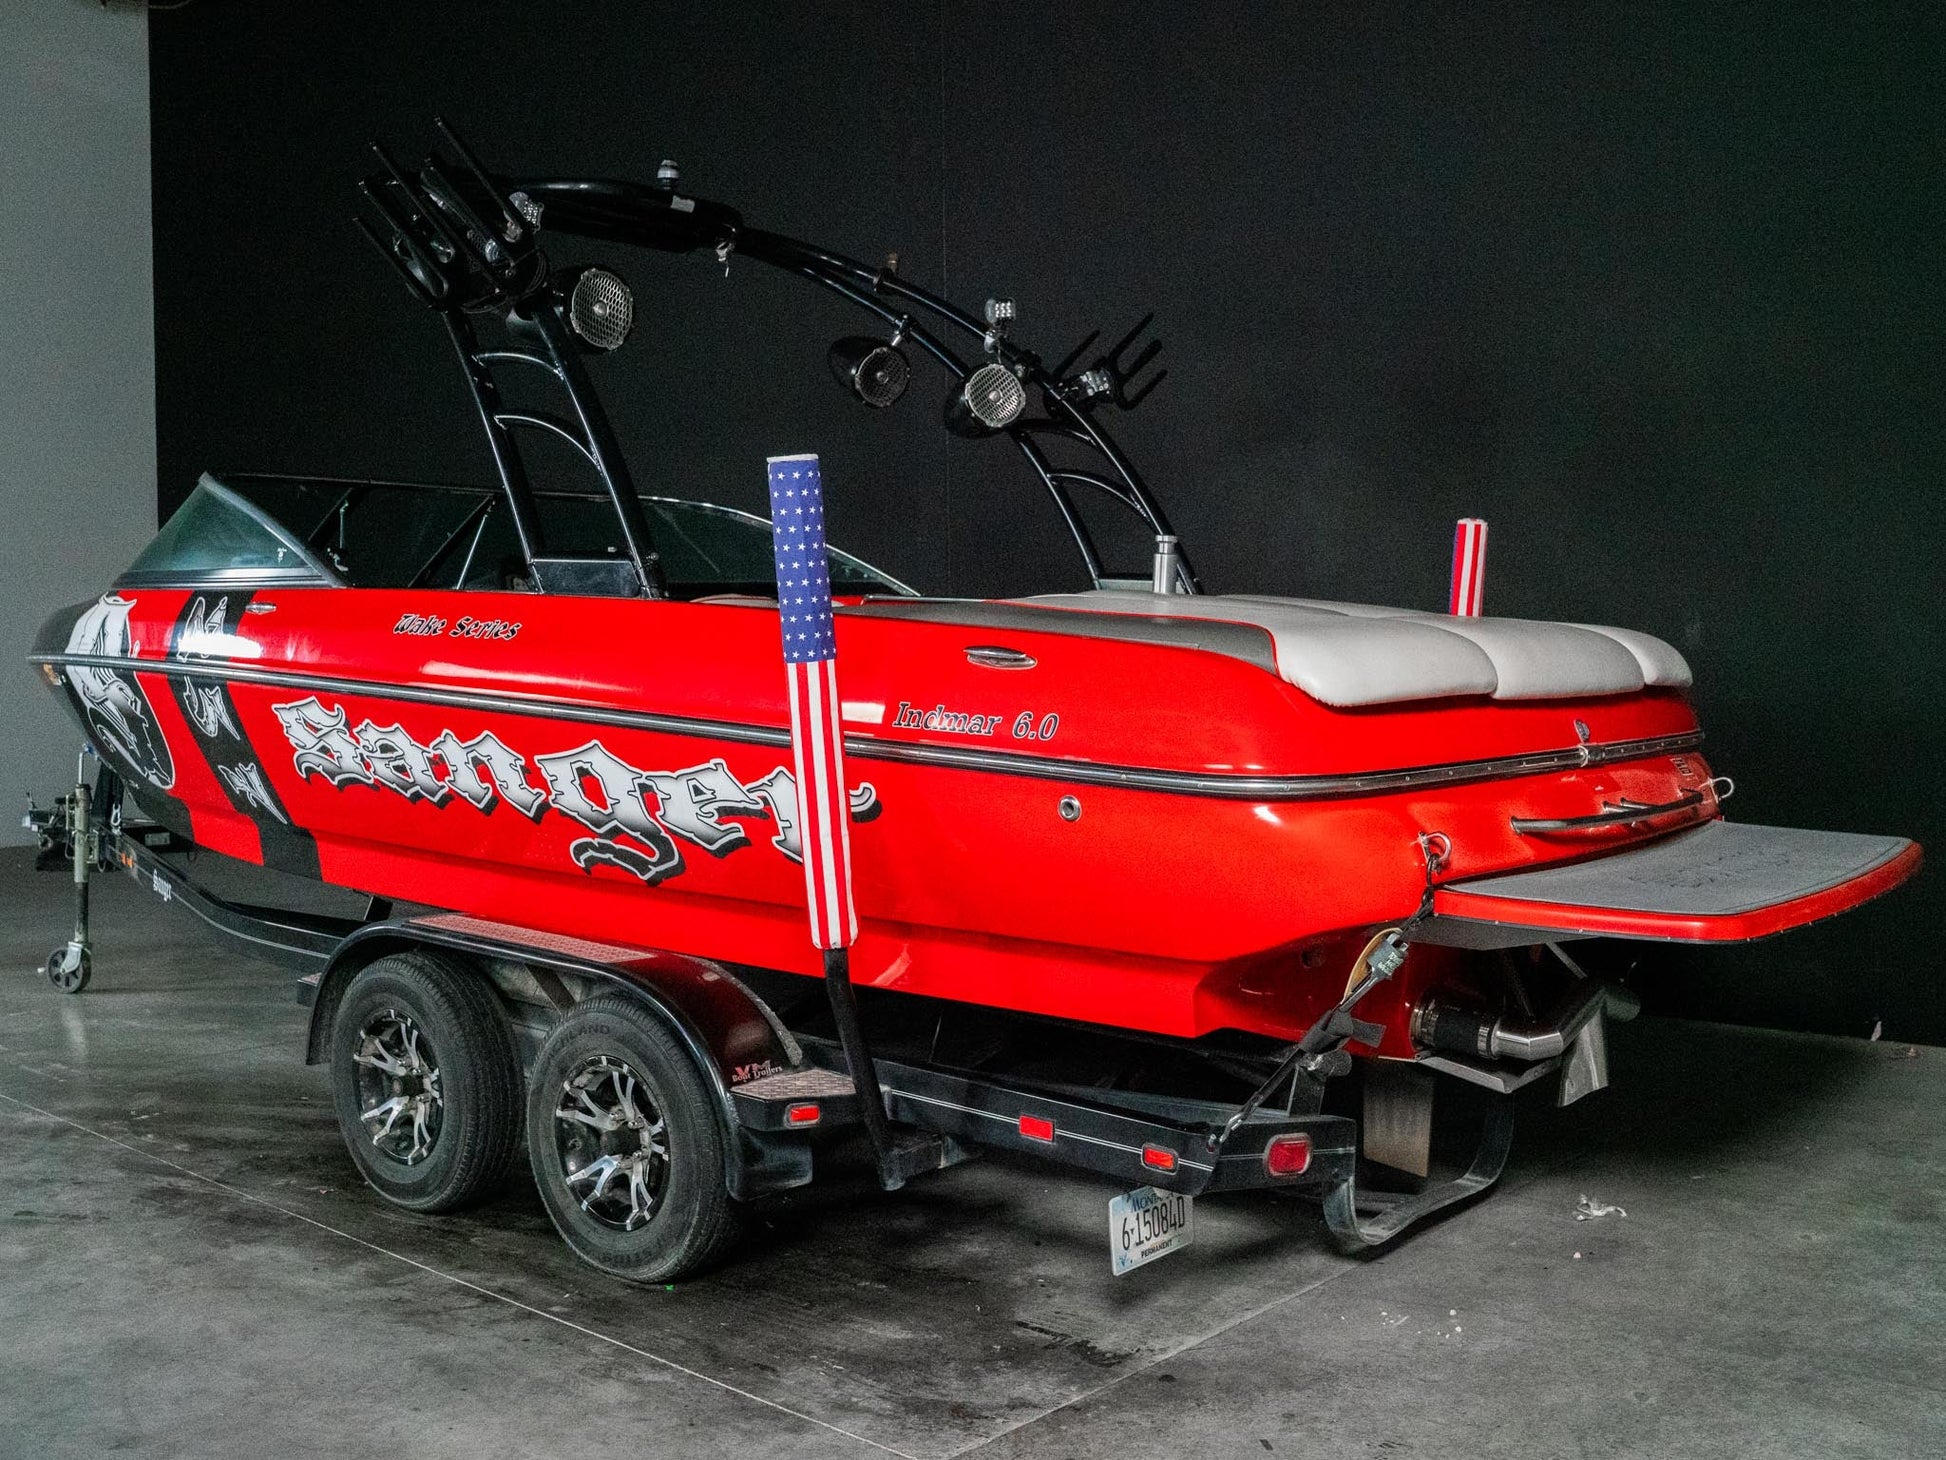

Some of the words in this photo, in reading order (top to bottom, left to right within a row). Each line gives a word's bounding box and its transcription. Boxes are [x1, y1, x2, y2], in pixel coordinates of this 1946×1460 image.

[393, 613, 447, 636] Wake
[449, 616, 522, 640] Series
[892, 701, 1002, 737] Indmar
[1011, 711, 1060, 741] 6.0
[1141, 1239, 1174, 1258] PERMANENT
